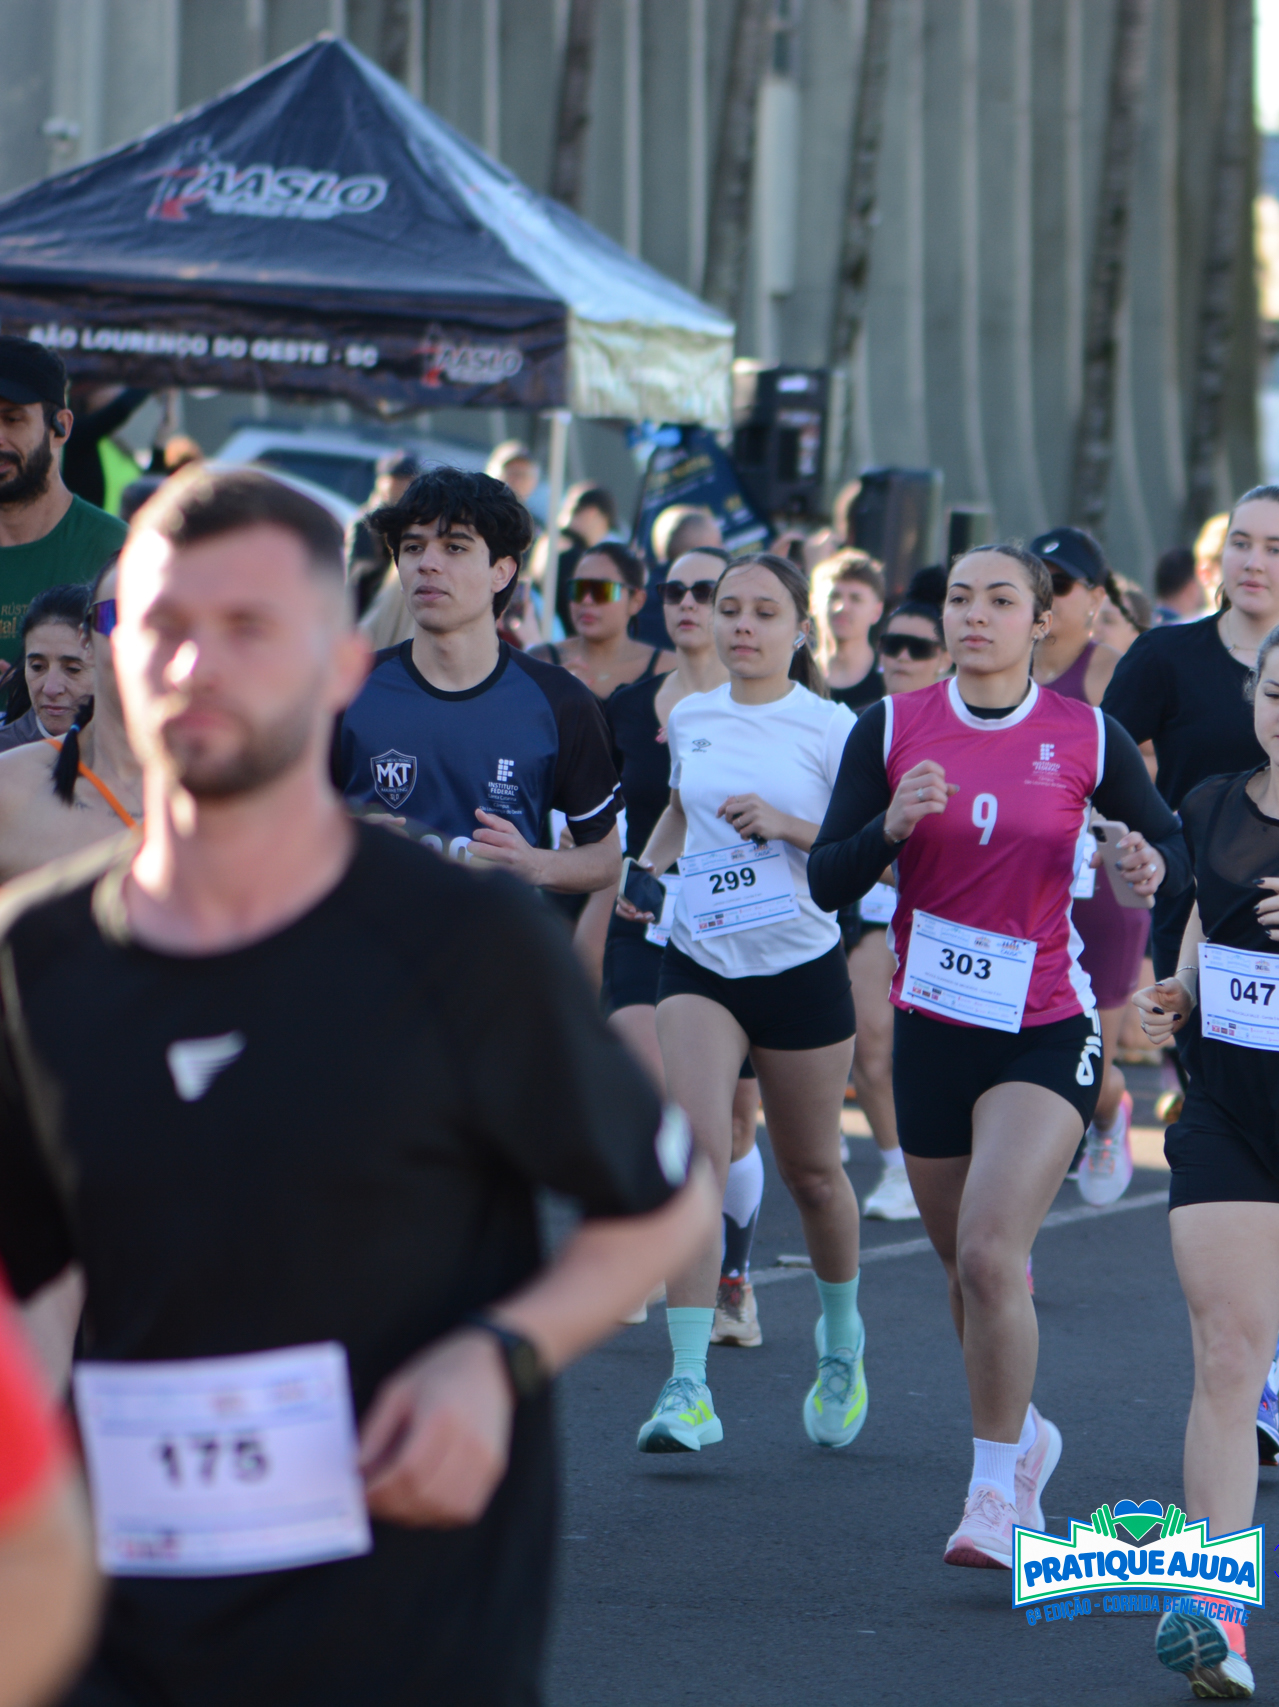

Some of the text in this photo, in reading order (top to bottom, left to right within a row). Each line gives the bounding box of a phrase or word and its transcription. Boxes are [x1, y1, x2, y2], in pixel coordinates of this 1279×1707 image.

[28, 322, 79, 349] SÃO
[81, 327, 208, 358] LOURENÇO
[212, 335, 248, 359] DO
[250, 337, 329, 364] OESTE
[376, 762, 411, 788] MKT
[488, 781, 519, 791] INSTITUTO
[490, 787, 515, 796] FEDERAL
[972, 793, 998, 846] 9
[709, 867, 756, 895] 299
[940, 948, 991, 980] 303
[1230, 977, 1276, 1006] 047
[158, 1433, 271, 1487] 175
